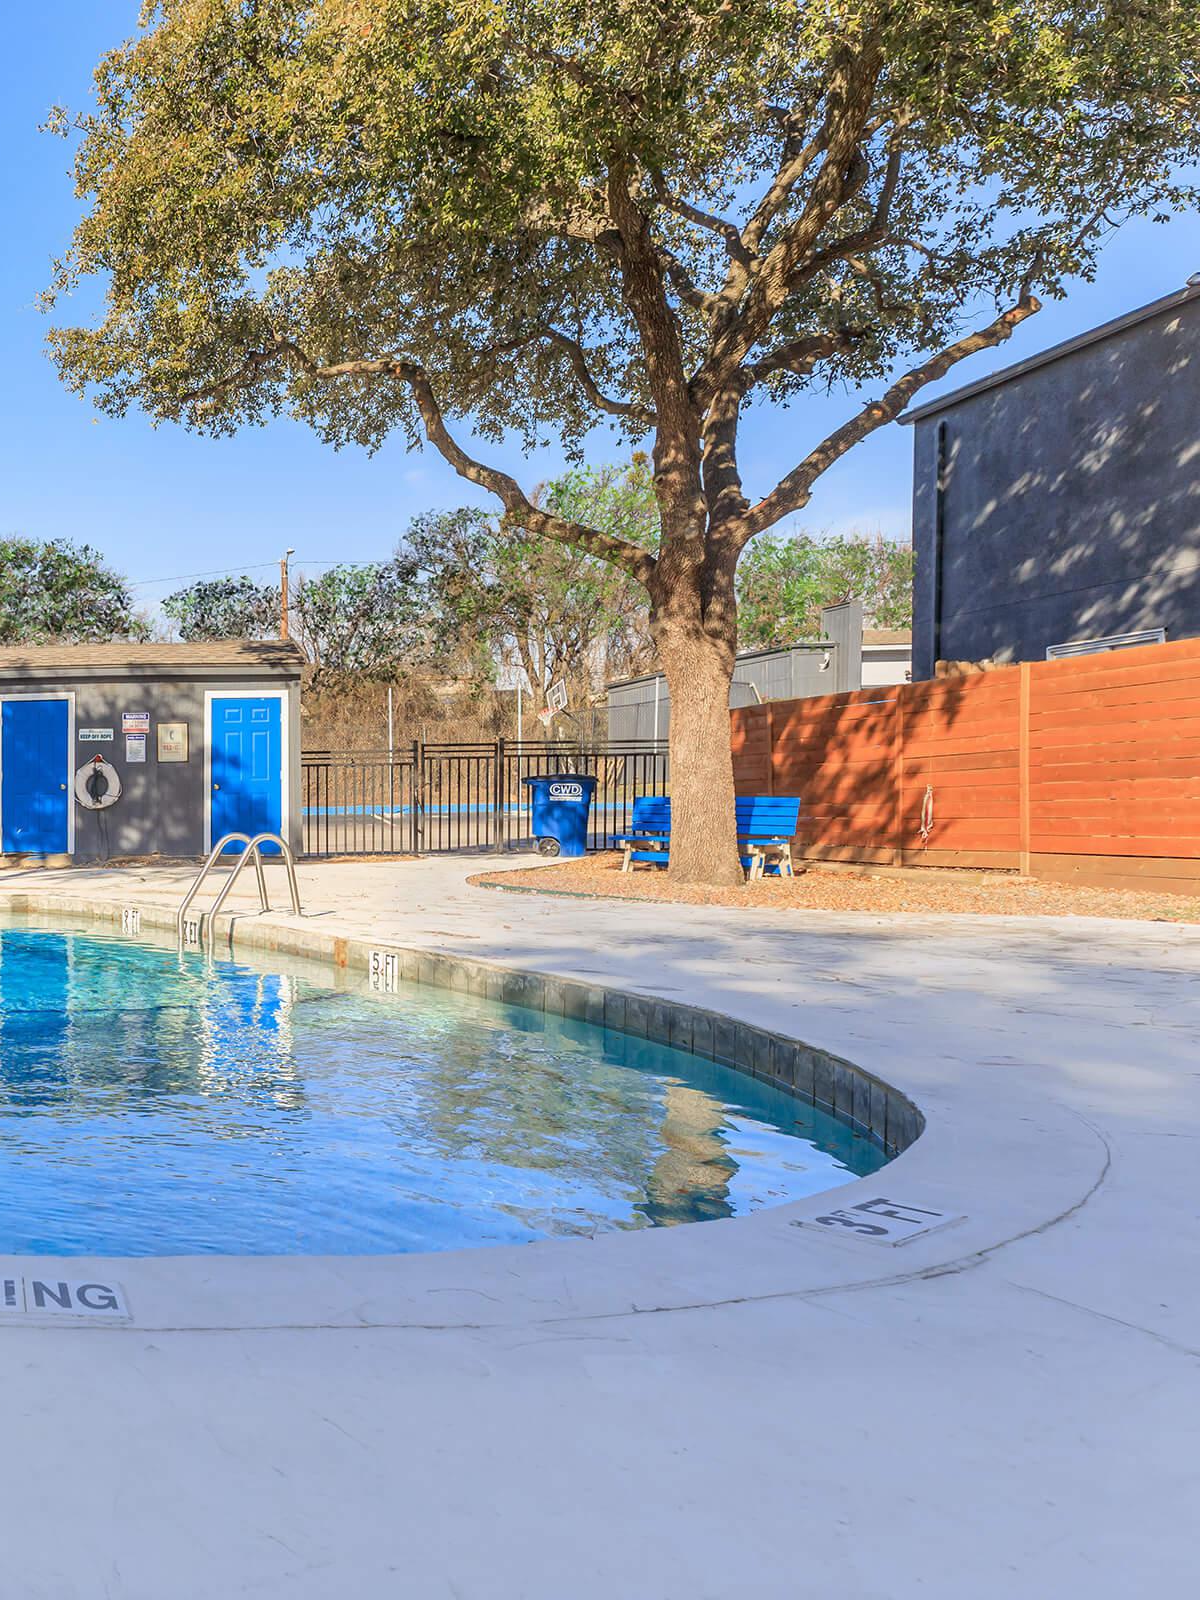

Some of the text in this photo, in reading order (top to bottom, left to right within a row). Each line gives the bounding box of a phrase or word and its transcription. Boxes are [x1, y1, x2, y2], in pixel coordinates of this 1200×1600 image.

[552, 784, 580, 795] CWD
[372, 952, 380, 971] 5
[850, 1197, 944, 1224] FT
[815, 1215, 889, 1236] 3
